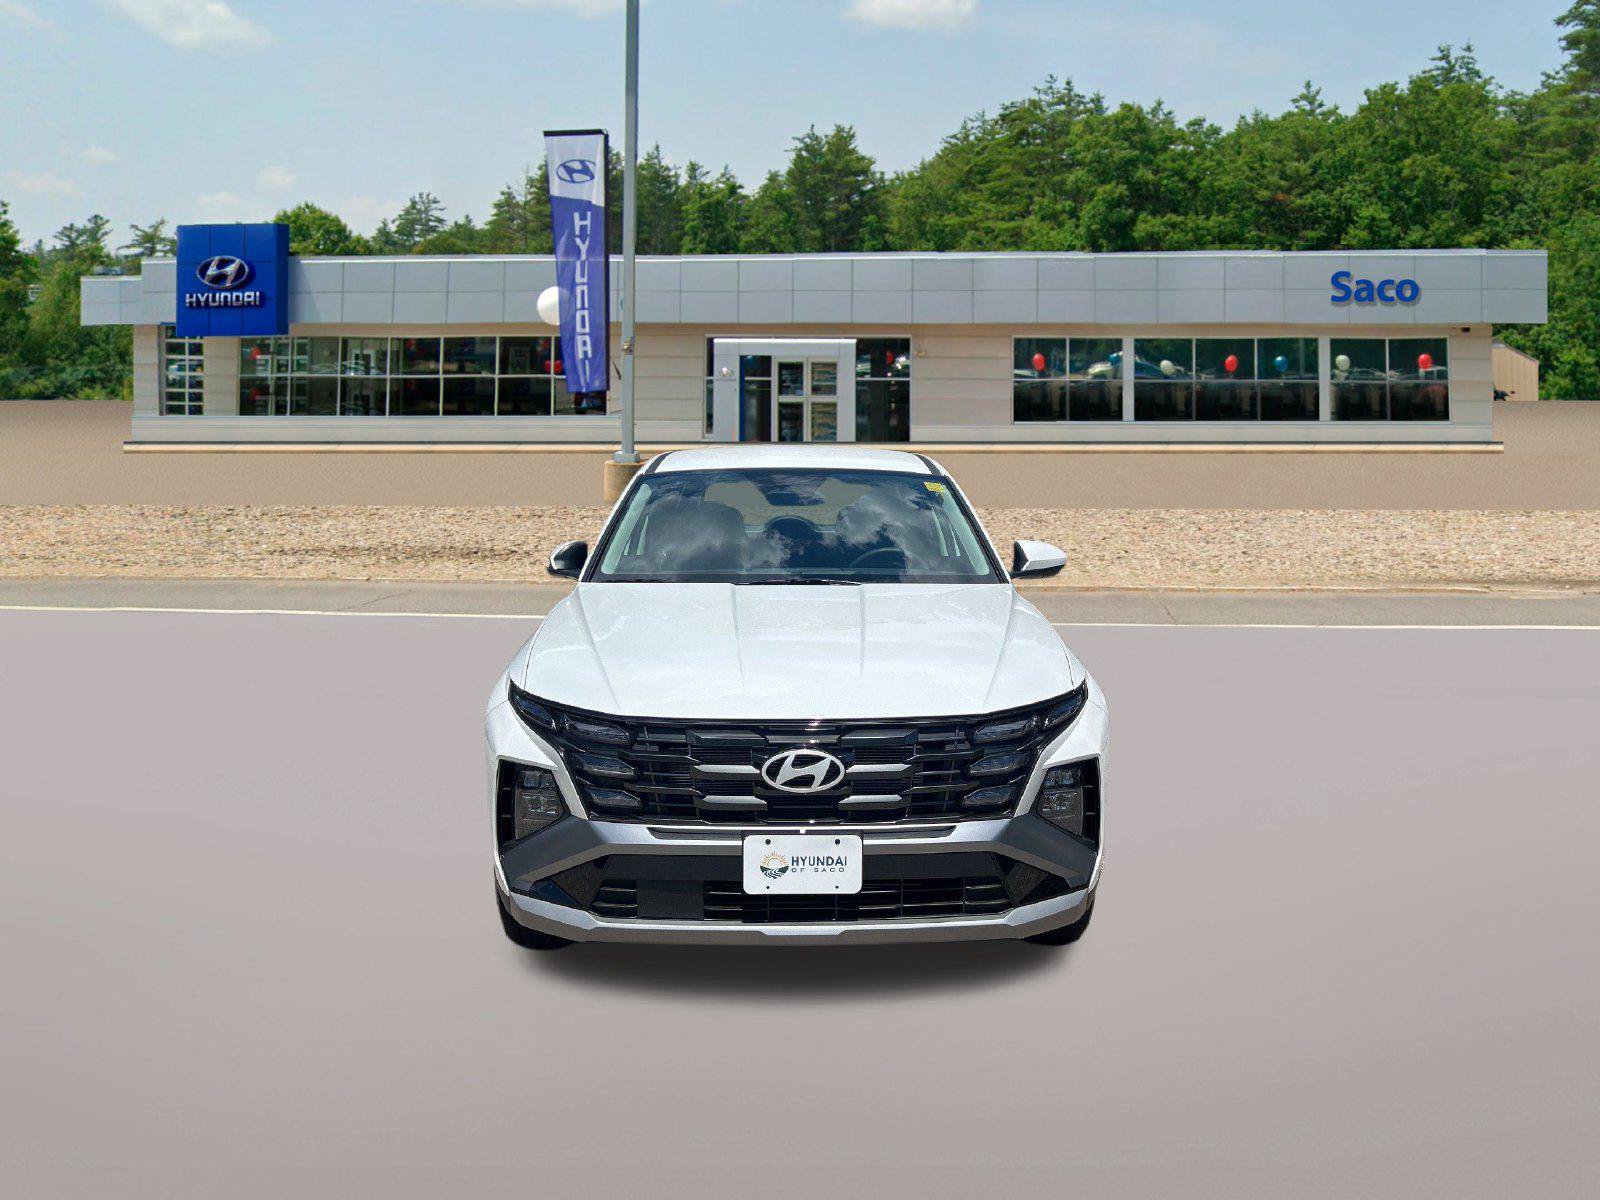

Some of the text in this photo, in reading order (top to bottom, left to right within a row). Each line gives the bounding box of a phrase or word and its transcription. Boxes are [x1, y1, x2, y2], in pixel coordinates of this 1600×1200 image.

[573, 211, 592, 383] HYUNDAI
[1330, 270, 1419, 303] Saco
[185, 291, 261, 307] HYUNDAI
[791, 856, 847, 867] HYUNDAI
